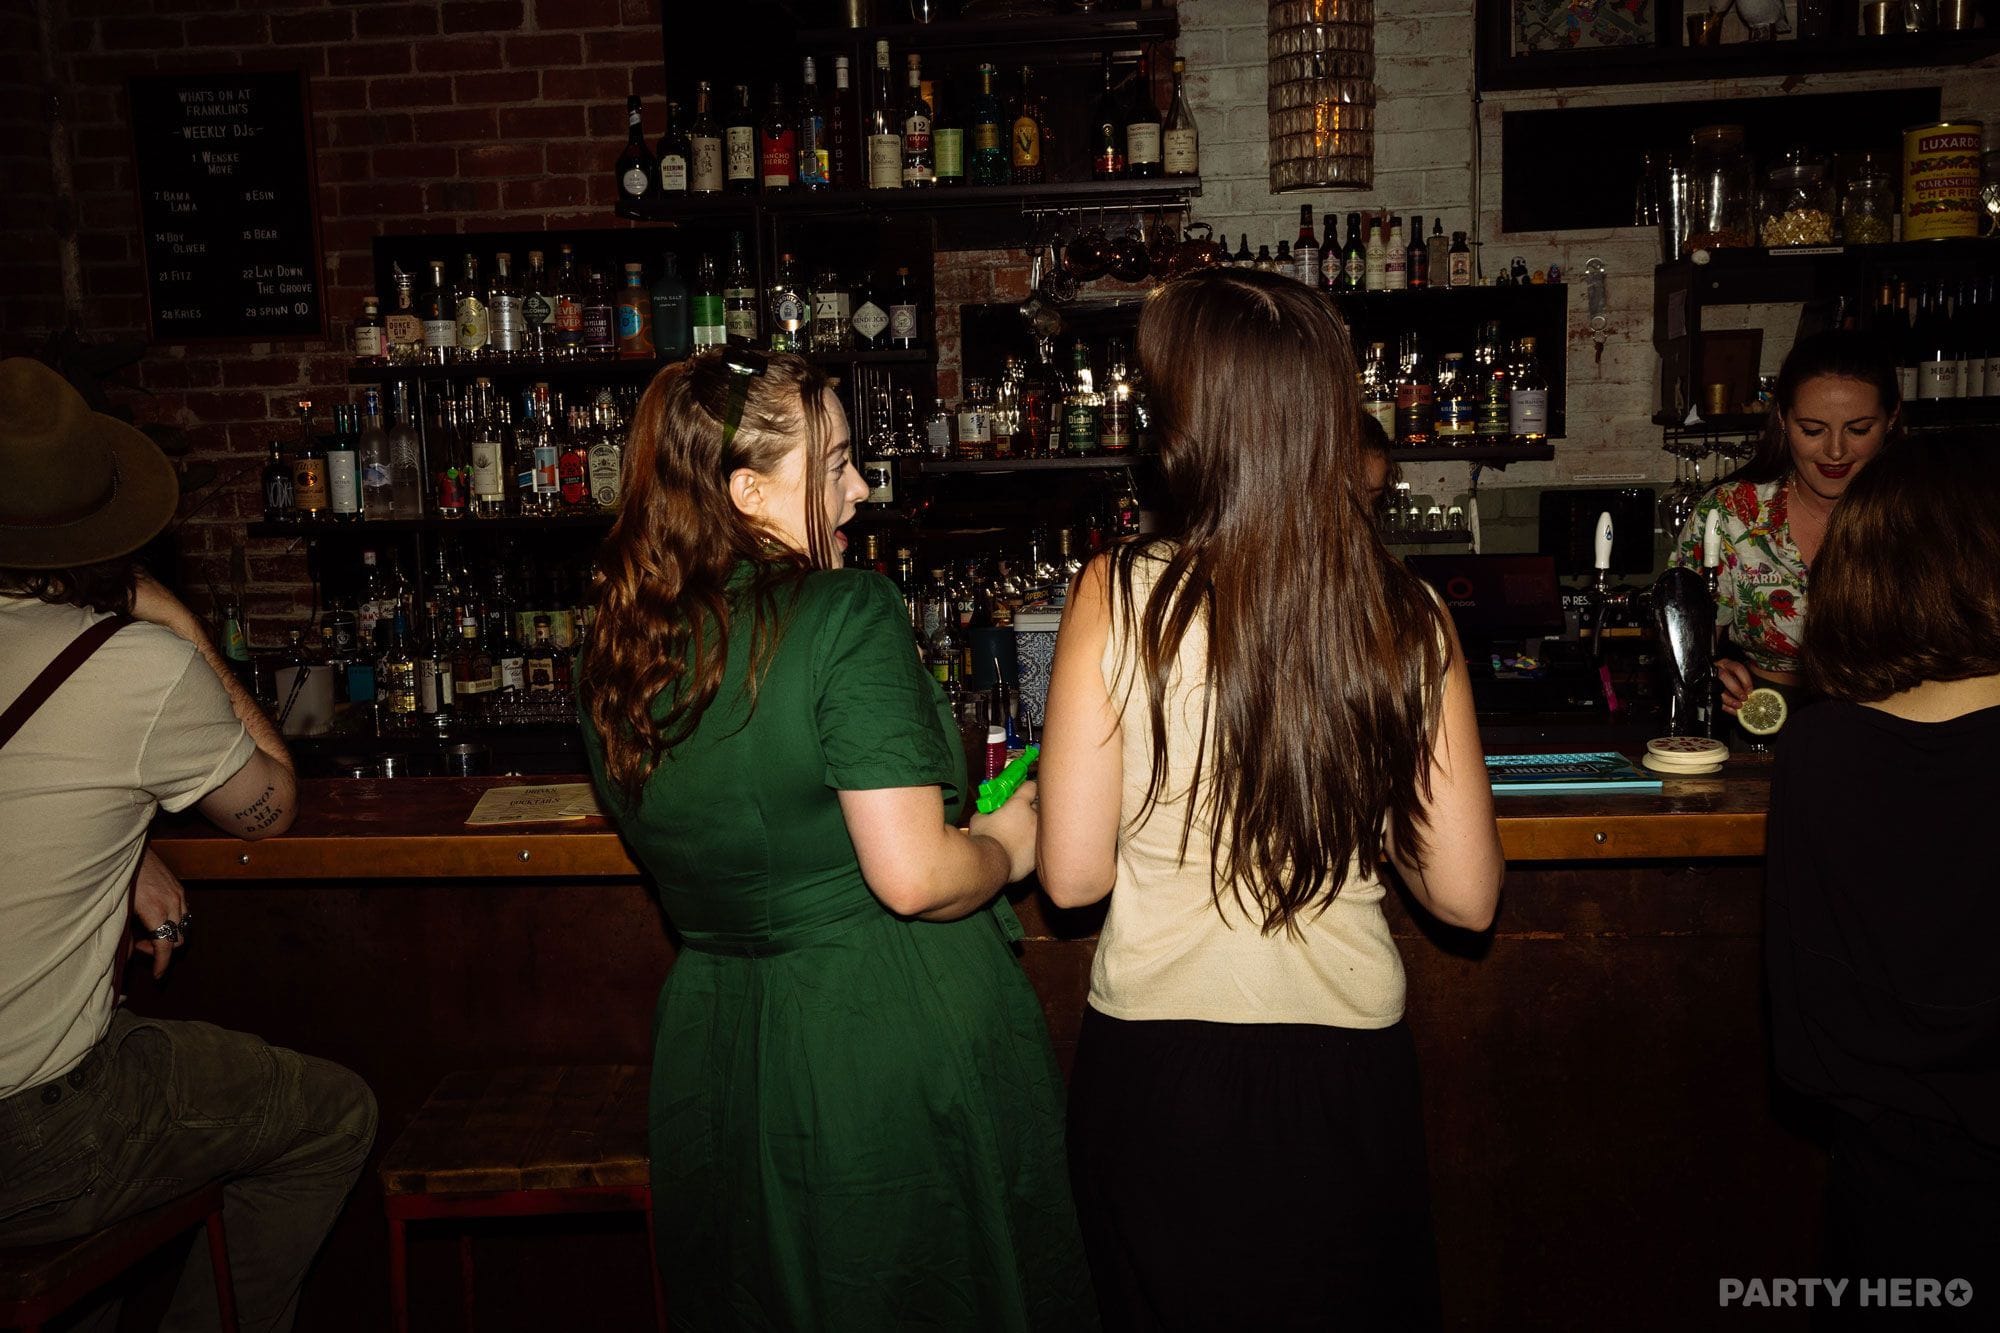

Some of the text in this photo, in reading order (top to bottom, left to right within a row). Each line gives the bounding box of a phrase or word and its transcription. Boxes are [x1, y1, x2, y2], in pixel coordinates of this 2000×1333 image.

[178, 89, 251, 103] WHAT'S ON AT
[186, 104, 249, 116] FRANKLIN'S
[182, 126, 226, 139] WEEKLY
[913, 121, 925, 132] 12
[1922, 137, 1980, 151] LUXARDO
[1919, 178, 1979, 190] MARASCHIN
[1919, 189, 1980, 200] CHERRIE
[254, 229, 277, 239] BEAR
[277, 265, 303, 277] DOWN
[256, 281, 313, 294] THE GROOVE
